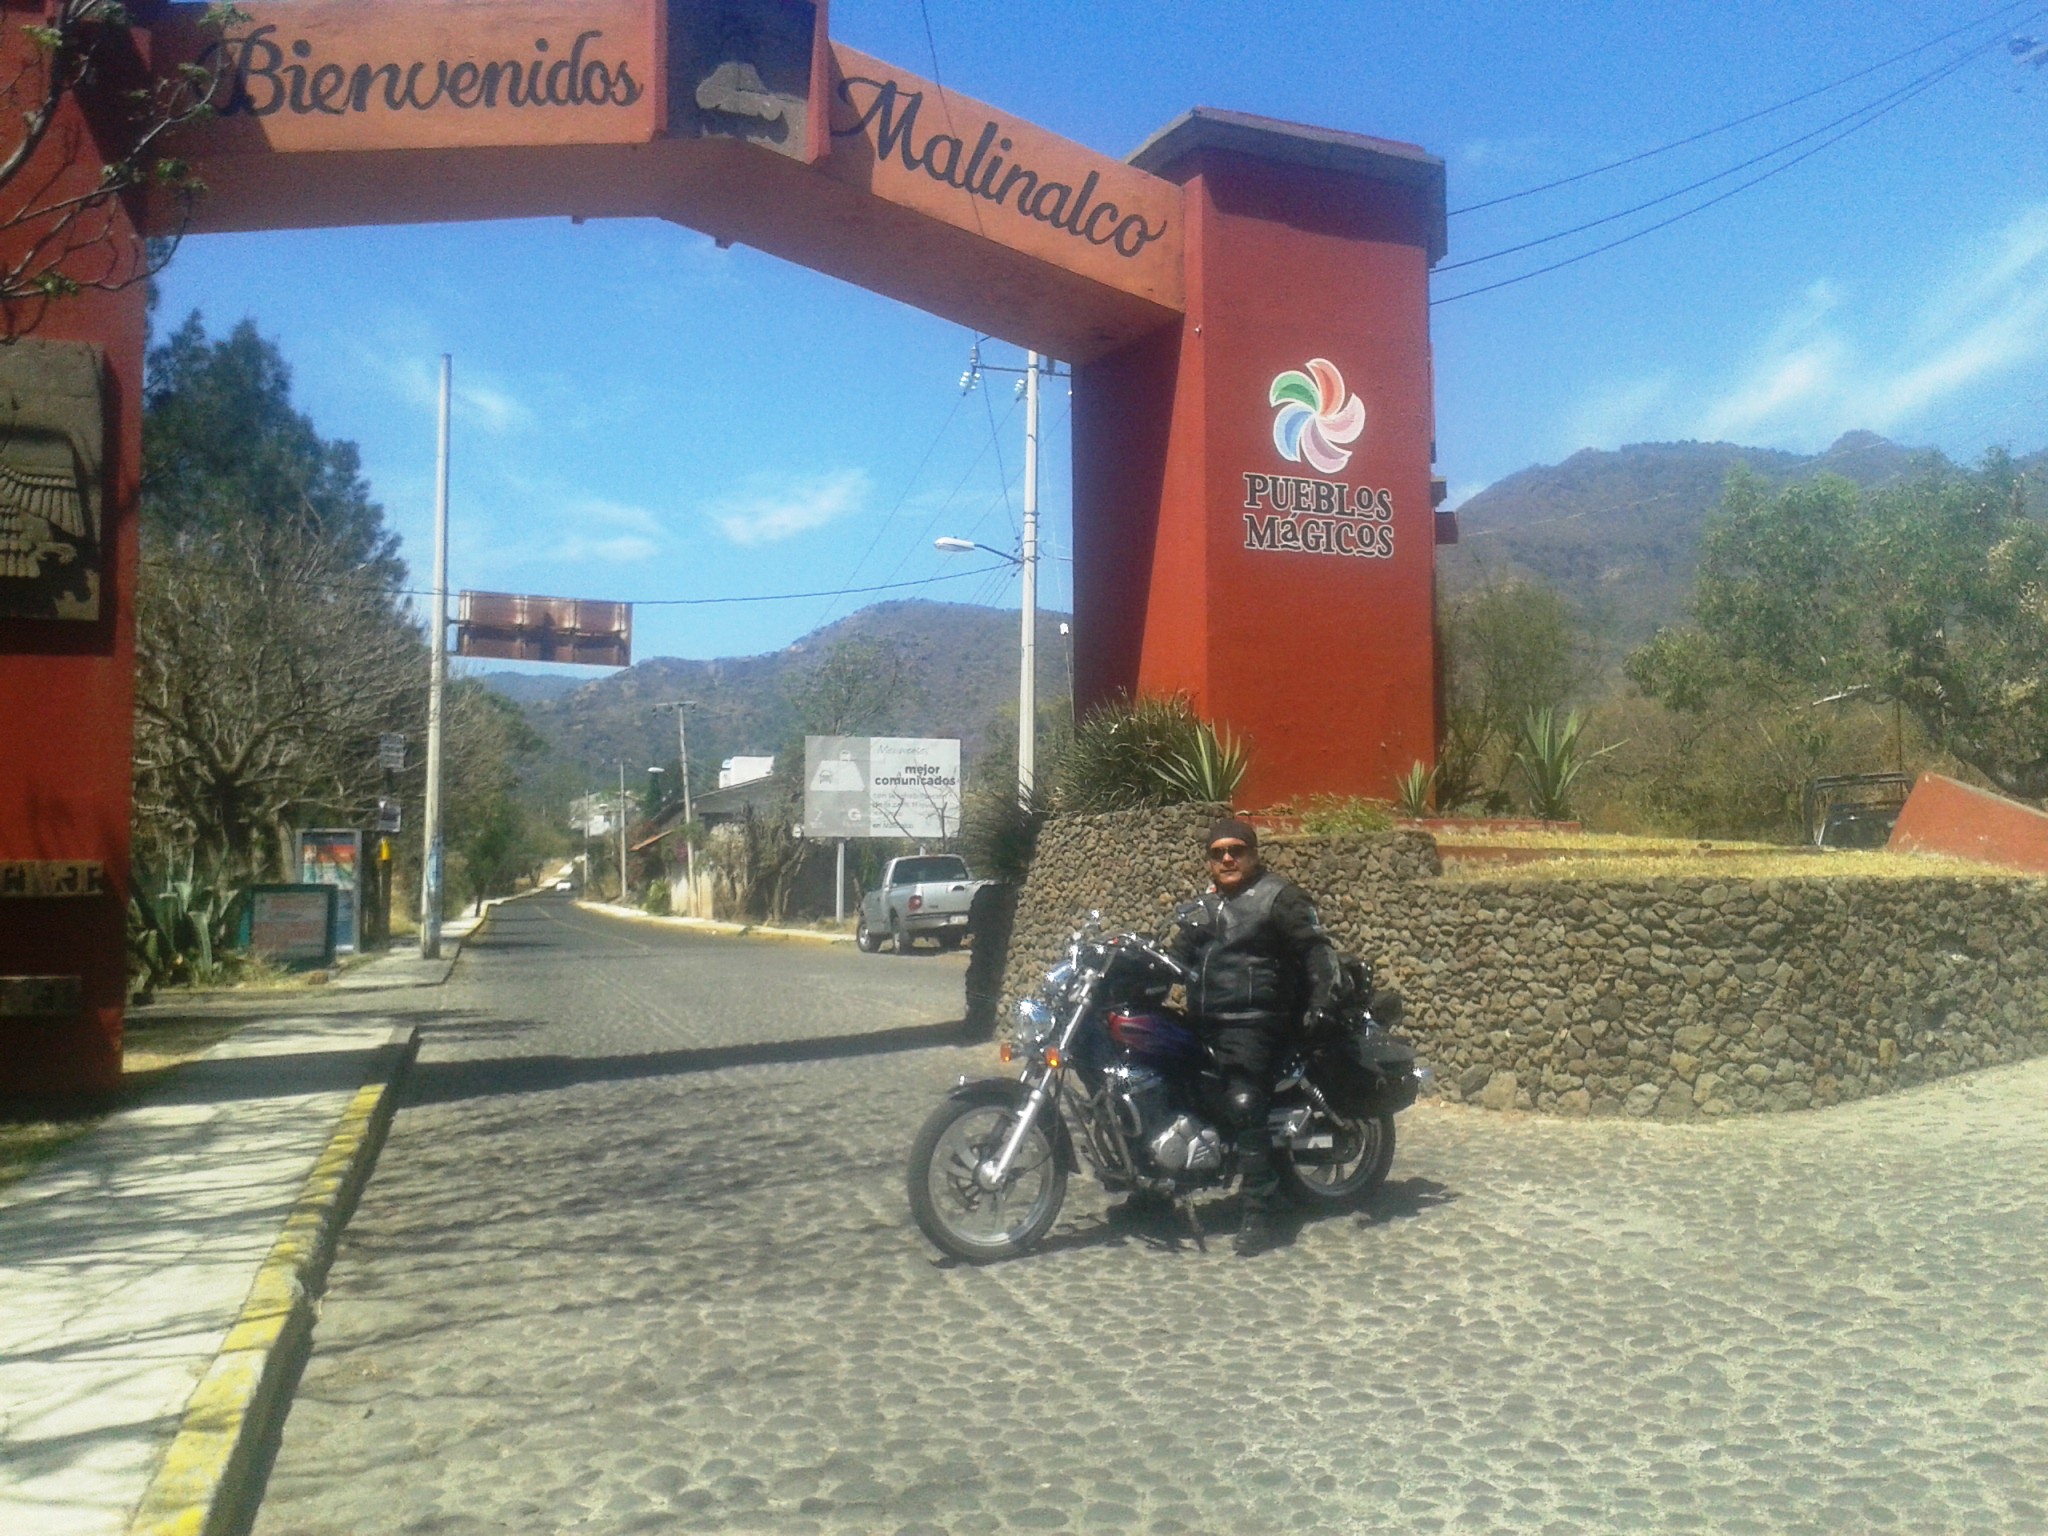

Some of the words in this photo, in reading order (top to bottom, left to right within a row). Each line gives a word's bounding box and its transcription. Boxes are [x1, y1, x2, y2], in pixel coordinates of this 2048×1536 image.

[194, 24, 644, 117] Bienvenidos
[830, 76, 1167, 258] Malinalco
[1243, 472, 1393, 522] PUEBLOS
[874, 775, 956, 785] comunicados
[904, 763, 940, 776] mejor
